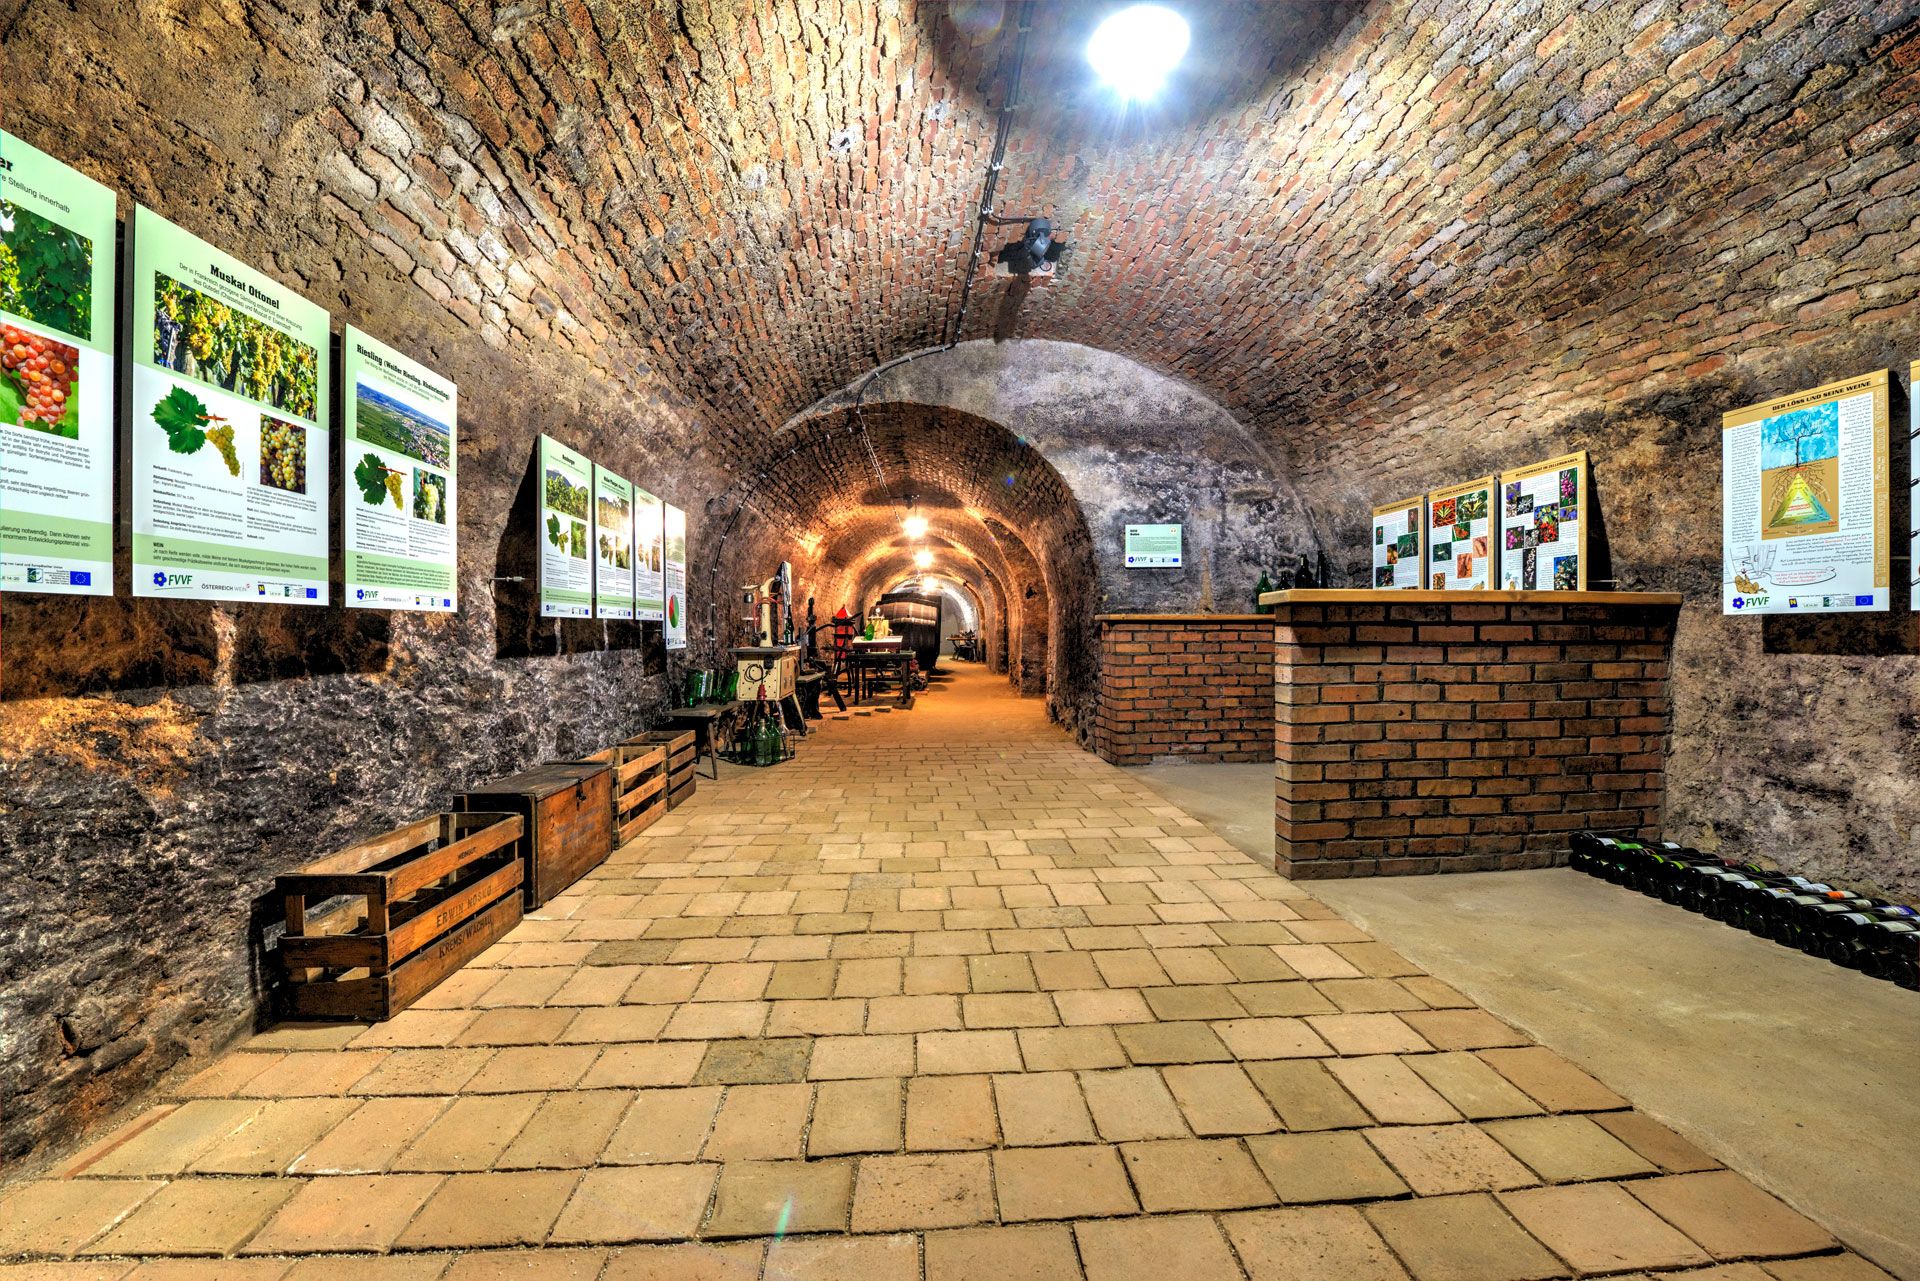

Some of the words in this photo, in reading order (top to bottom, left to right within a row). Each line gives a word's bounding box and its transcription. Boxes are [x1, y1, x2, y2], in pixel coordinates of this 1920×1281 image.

[9, 177, 37, 198] Stellung
[39, 192, 70, 213] innerhalb
[210, 264, 246, 292] Muskat
[248, 285, 280, 310] Ottonel
[357, 344, 382, 366] Riesling
[1787, 398, 1805, 406] LÖSS
[1823, 389, 1844, 397] SEINE
[1846, 381, 1871, 391] WEINE
[1875, 426, 1886, 453] und
[1874, 455, 1886, 488] Löss
[168, 575, 193, 585] FVVF
[1746, 596, 1769, 607] FVVF
[436, 902, 464, 928] ERWIN
